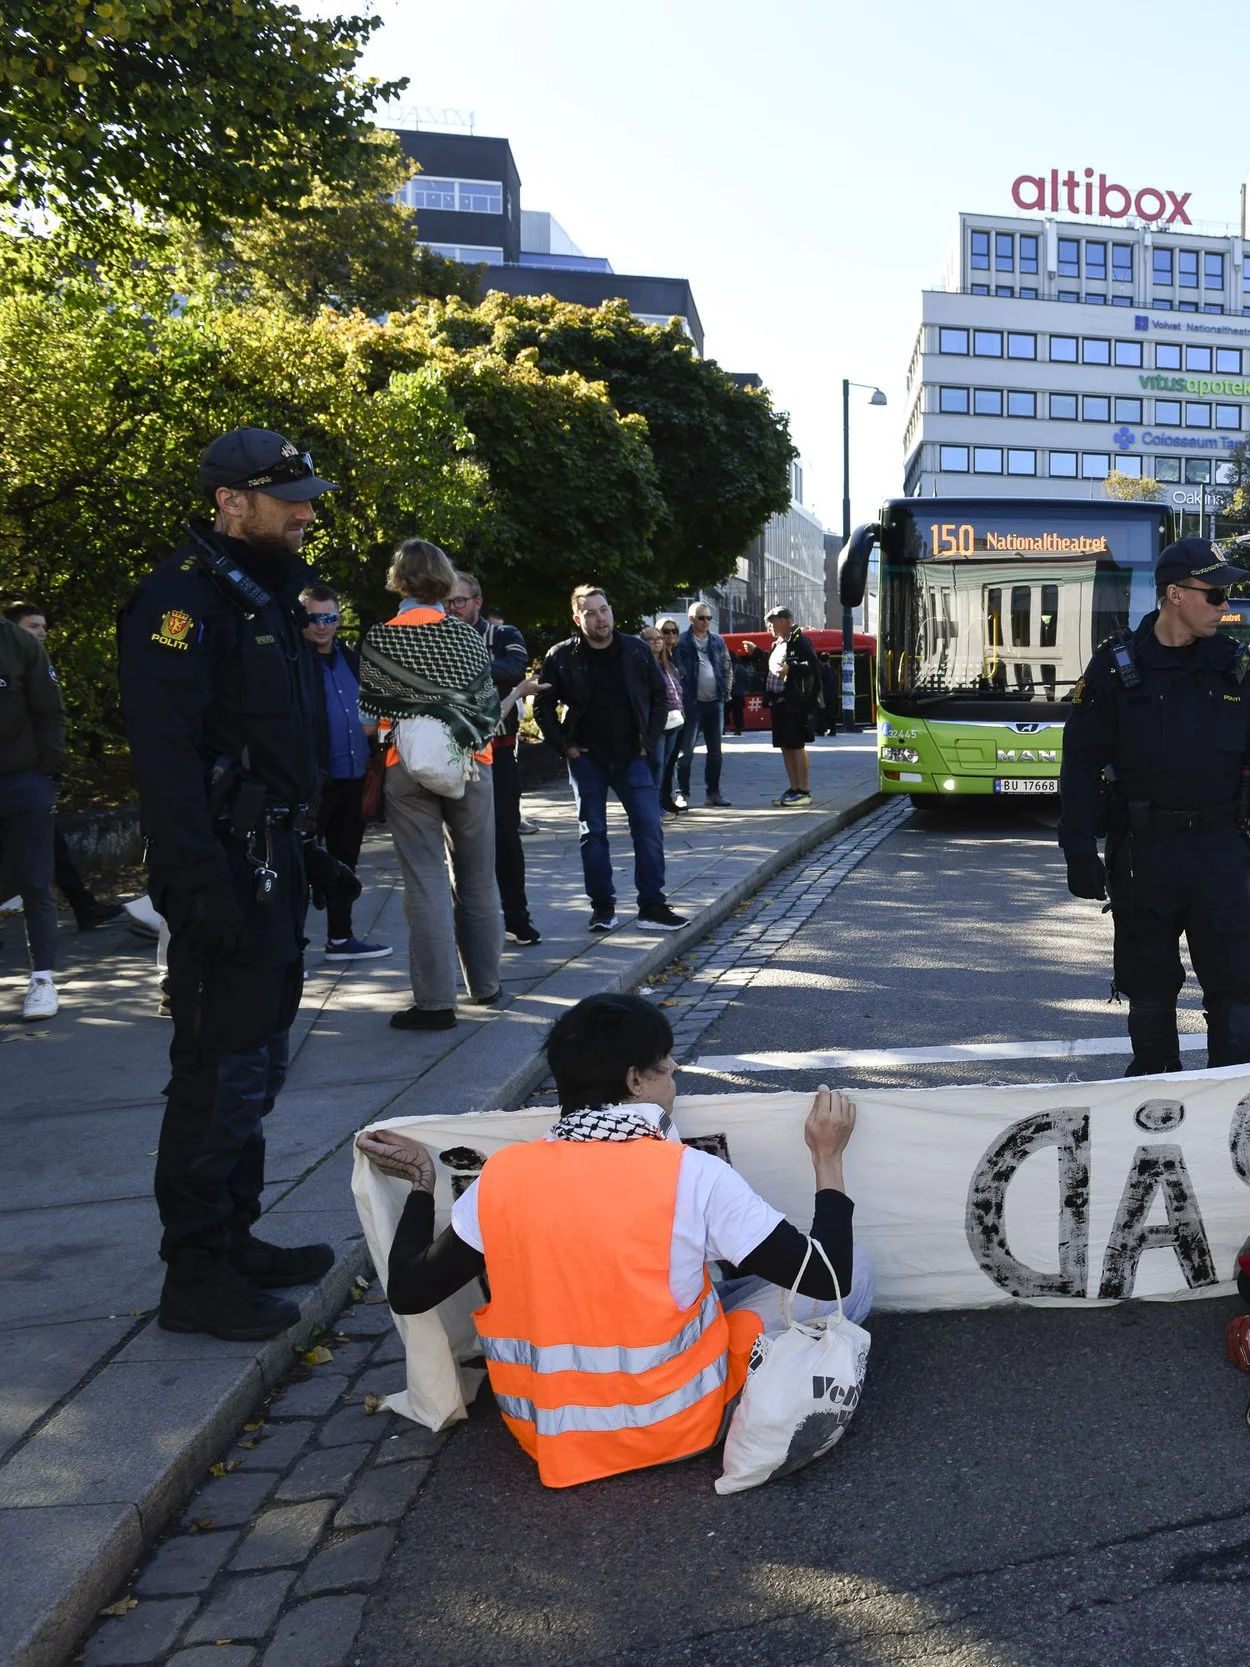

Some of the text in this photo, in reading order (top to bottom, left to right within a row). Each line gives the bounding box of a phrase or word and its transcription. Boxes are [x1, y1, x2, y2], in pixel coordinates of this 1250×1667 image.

[1011, 167, 1193, 225] altibox
[1141, 431, 1218, 449] Colosseum
[930, 524, 1107, 557] 150 Nationaltheatret
[151, 633, 189, 651] POLITI
[888, 728, 918, 739] 32445
[997, 749, 1057, 763] MAN
[1003, 780, 1055, 792] BU 17668
